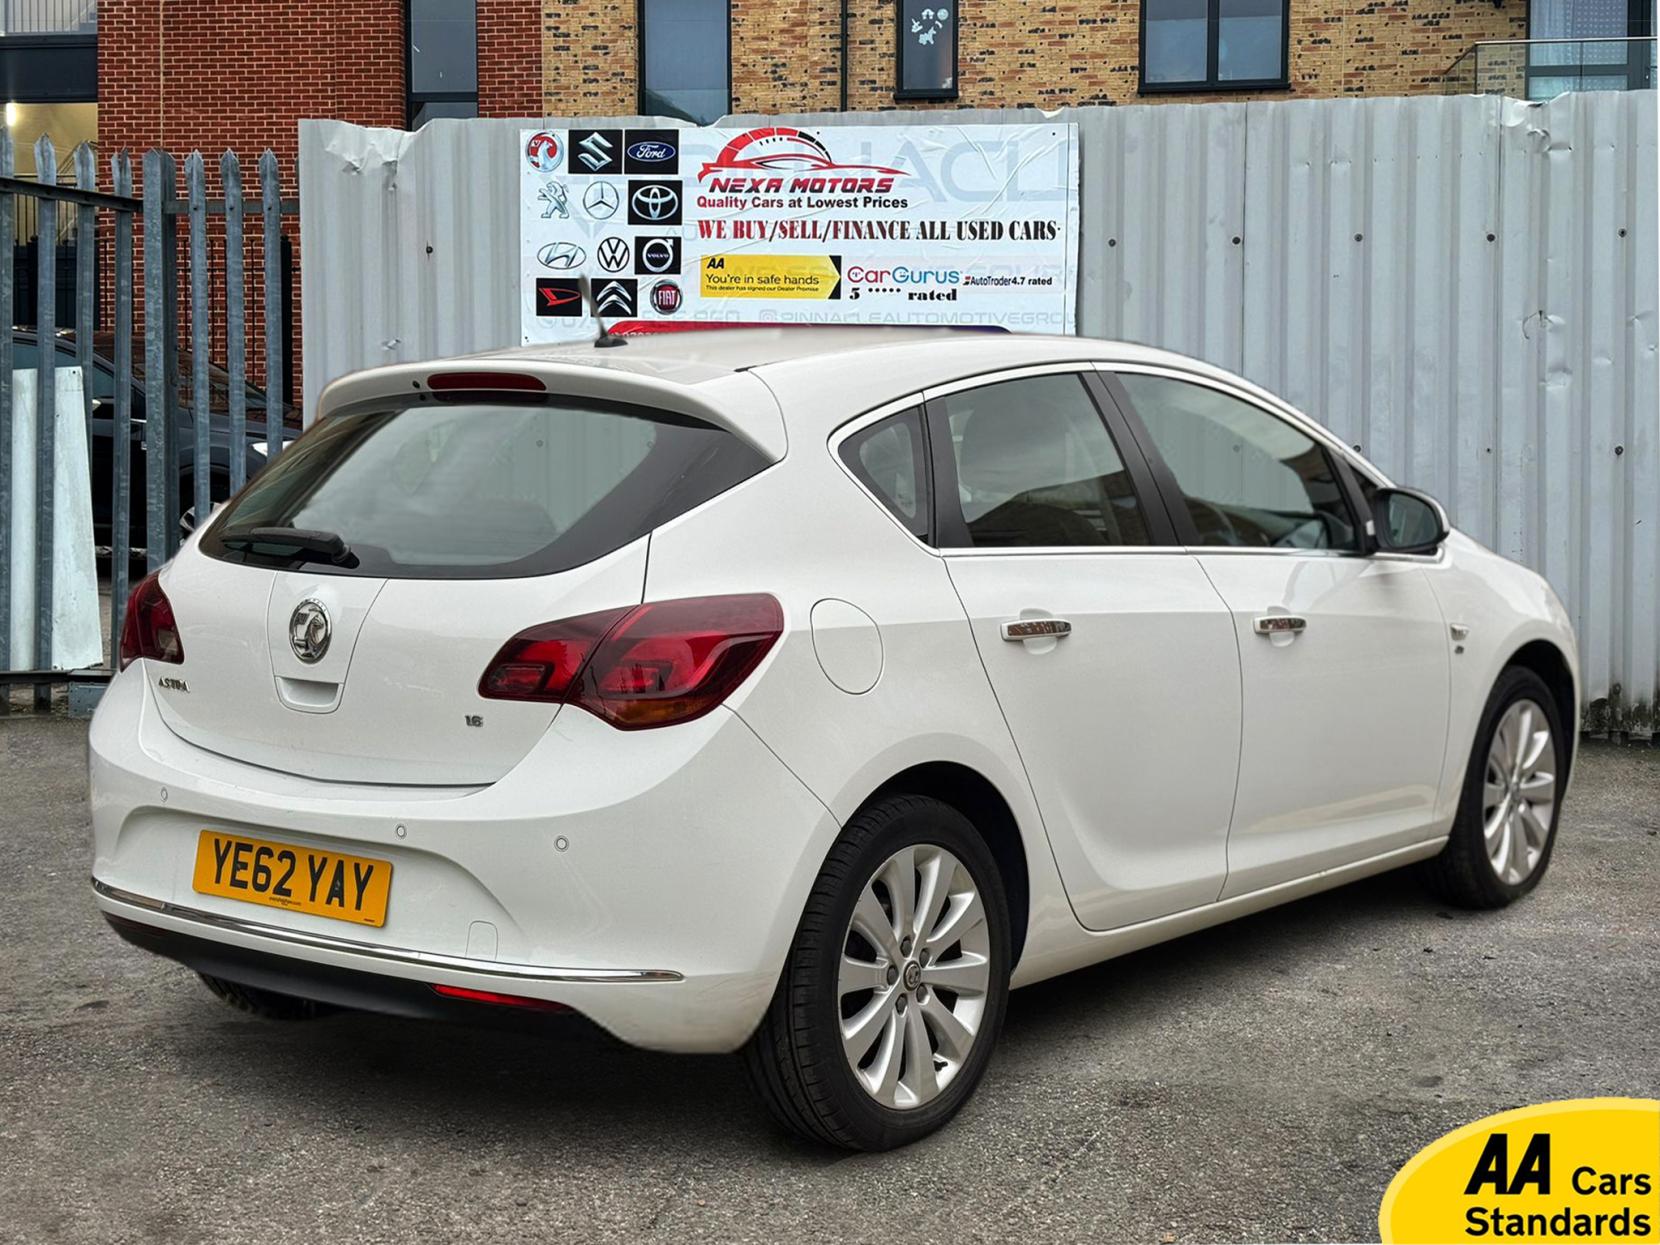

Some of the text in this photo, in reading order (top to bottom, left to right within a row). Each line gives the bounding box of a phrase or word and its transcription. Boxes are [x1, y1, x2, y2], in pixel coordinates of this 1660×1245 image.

[636, 144, 666, 158] Ford
[709, 177, 894, 193] NEXA MOTORS
[697, 196, 908, 210] Quality Cars at Lowest Prices
[697, 219, 727, 240] WE
[733, 219, 911, 242] BUY/SELL/FINANCE
[916, 220, 950, 240] ALL
[956, 220, 1004, 240] USED
[1009, 220, 1056, 240] CARS
[706, 257, 724, 269] AA
[706, 273, 819, 285] You're in safe hands
[847, 266, 960, 284] CarGurus
[1028, 276, 1052, 286] rated
[747, 285, 766, 293] signed
[849, 287, 957, 301] 5 rated
[658, 290, 676, 305] FIAT
[214, 838, 374, 911] YE62 YAY
